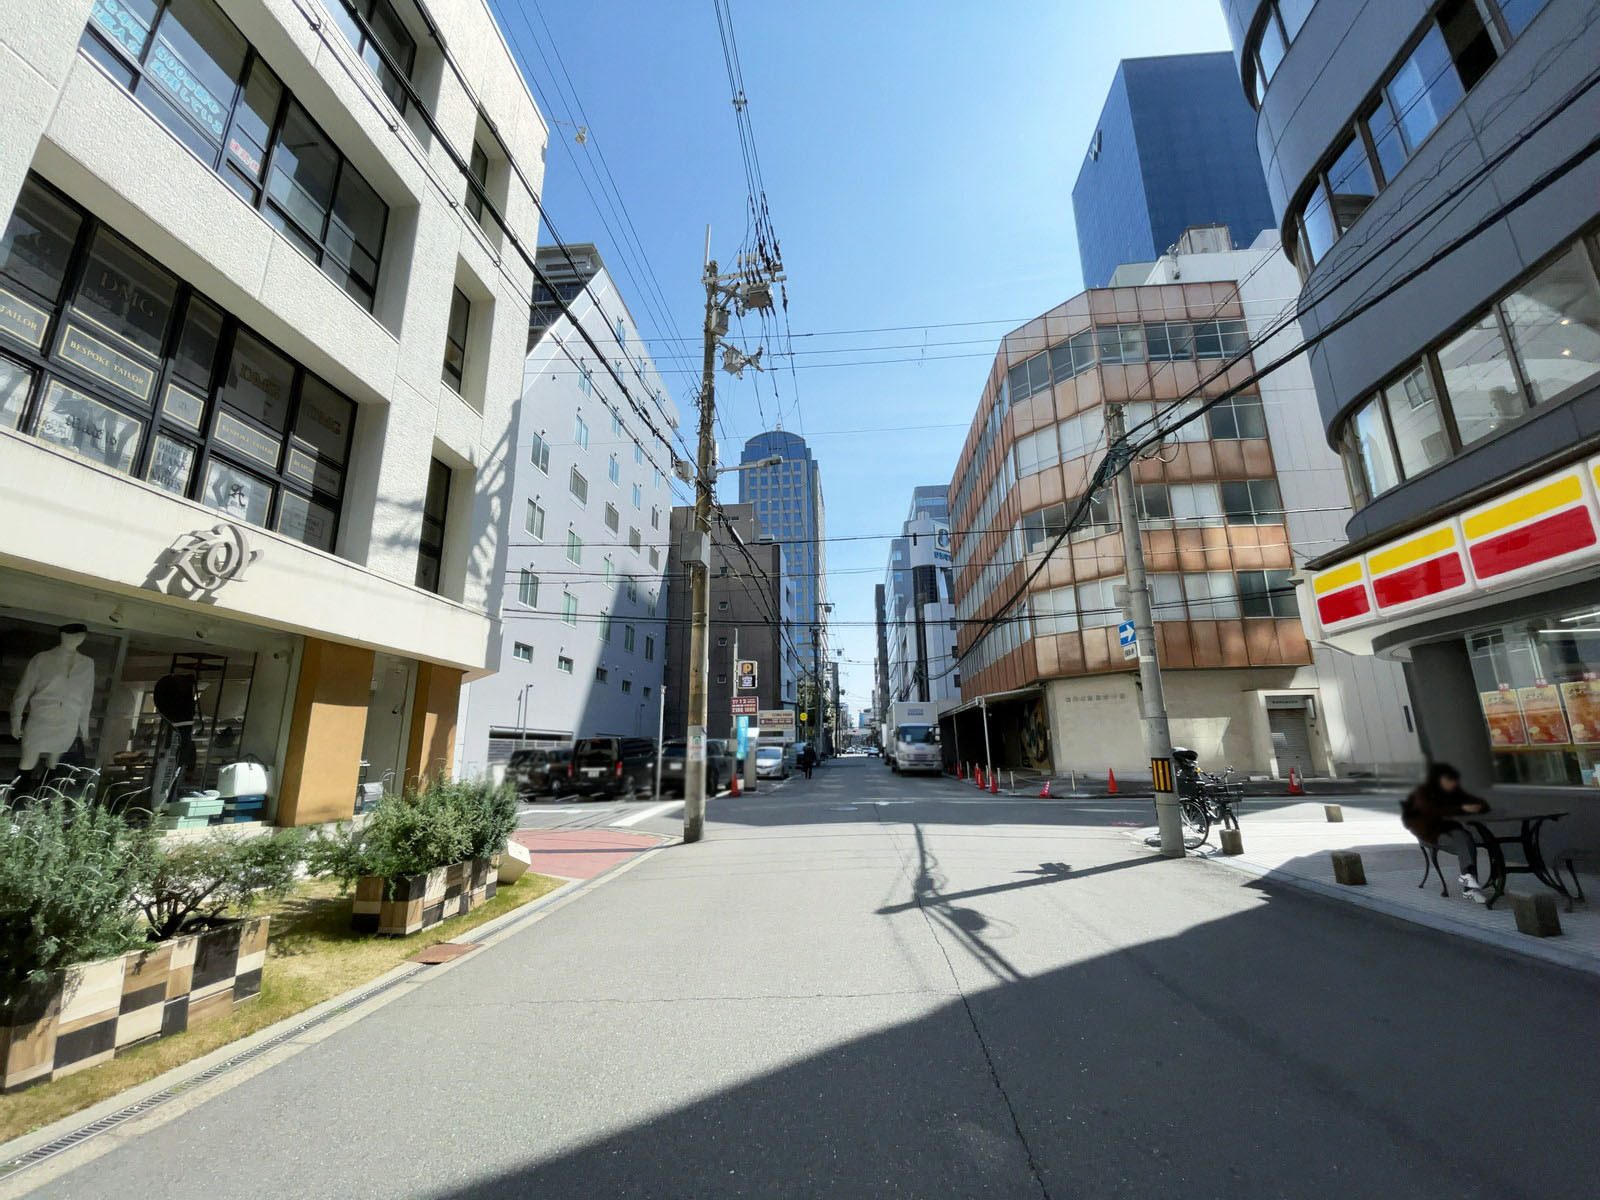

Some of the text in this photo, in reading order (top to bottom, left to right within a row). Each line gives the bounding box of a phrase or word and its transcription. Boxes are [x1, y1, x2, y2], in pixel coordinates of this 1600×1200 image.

[0, 304, 38, 332] TAILOR
[69, 340, 145, 385] BESPOKE TAILOR
[743, 663, 752, 673] P
